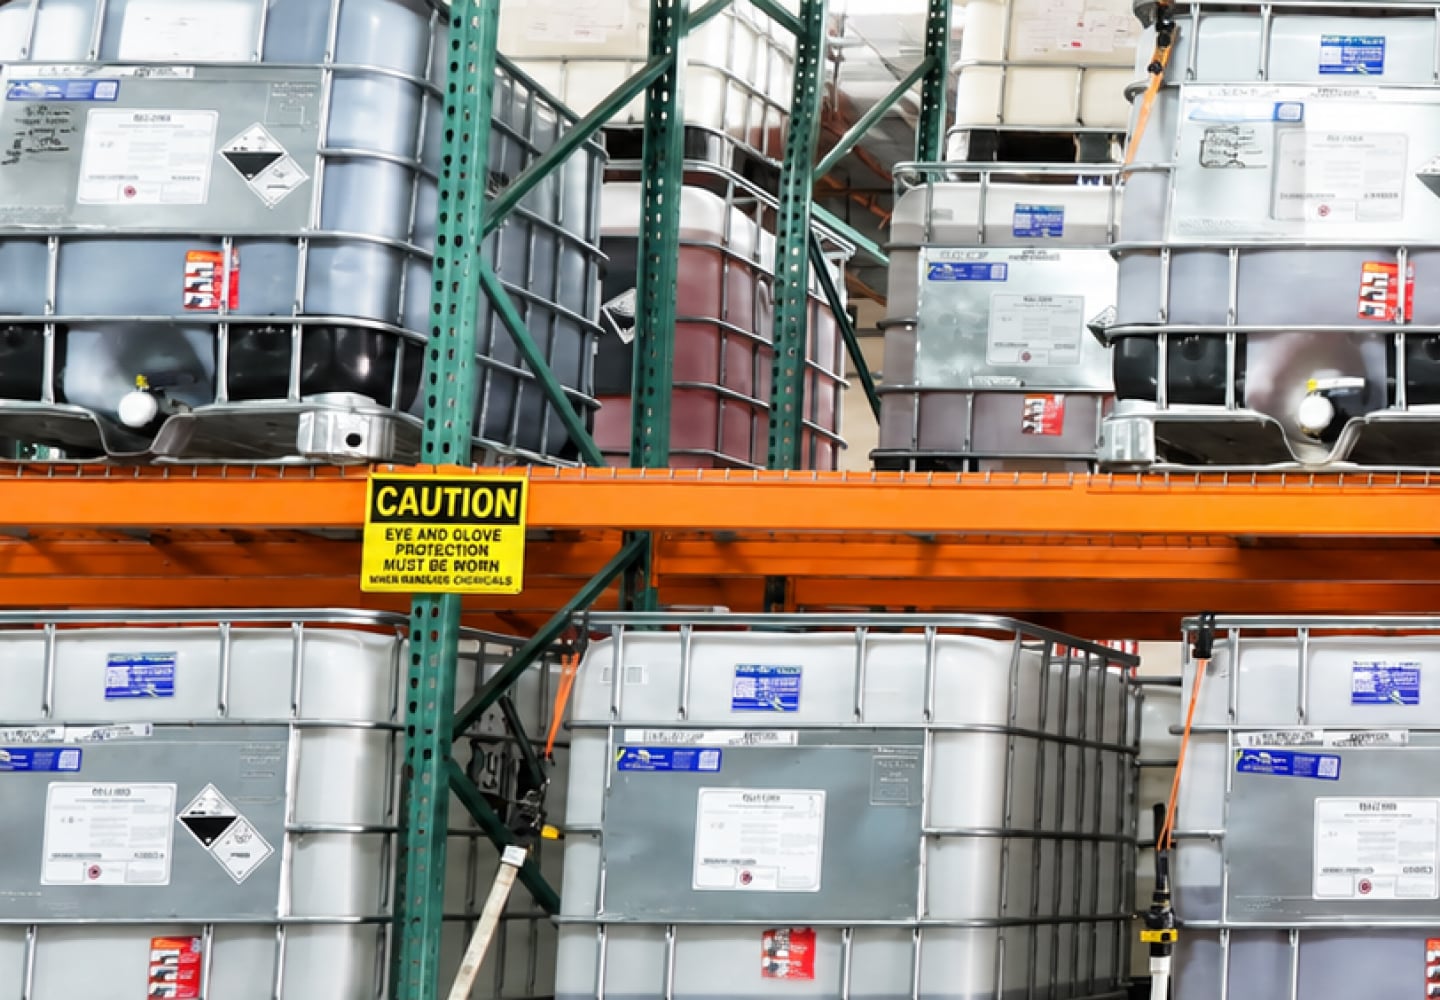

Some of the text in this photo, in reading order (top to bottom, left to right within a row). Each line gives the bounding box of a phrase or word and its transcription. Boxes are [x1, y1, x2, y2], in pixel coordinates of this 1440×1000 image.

[375, 485, 518, 519] CAUTION
[385, 528, 413, 541] EYE
[417, 528, 448, 542] AND
[395, 543, 489, 557] PROTECTION
[383, 558, 499, 573] MUST BE WORN
